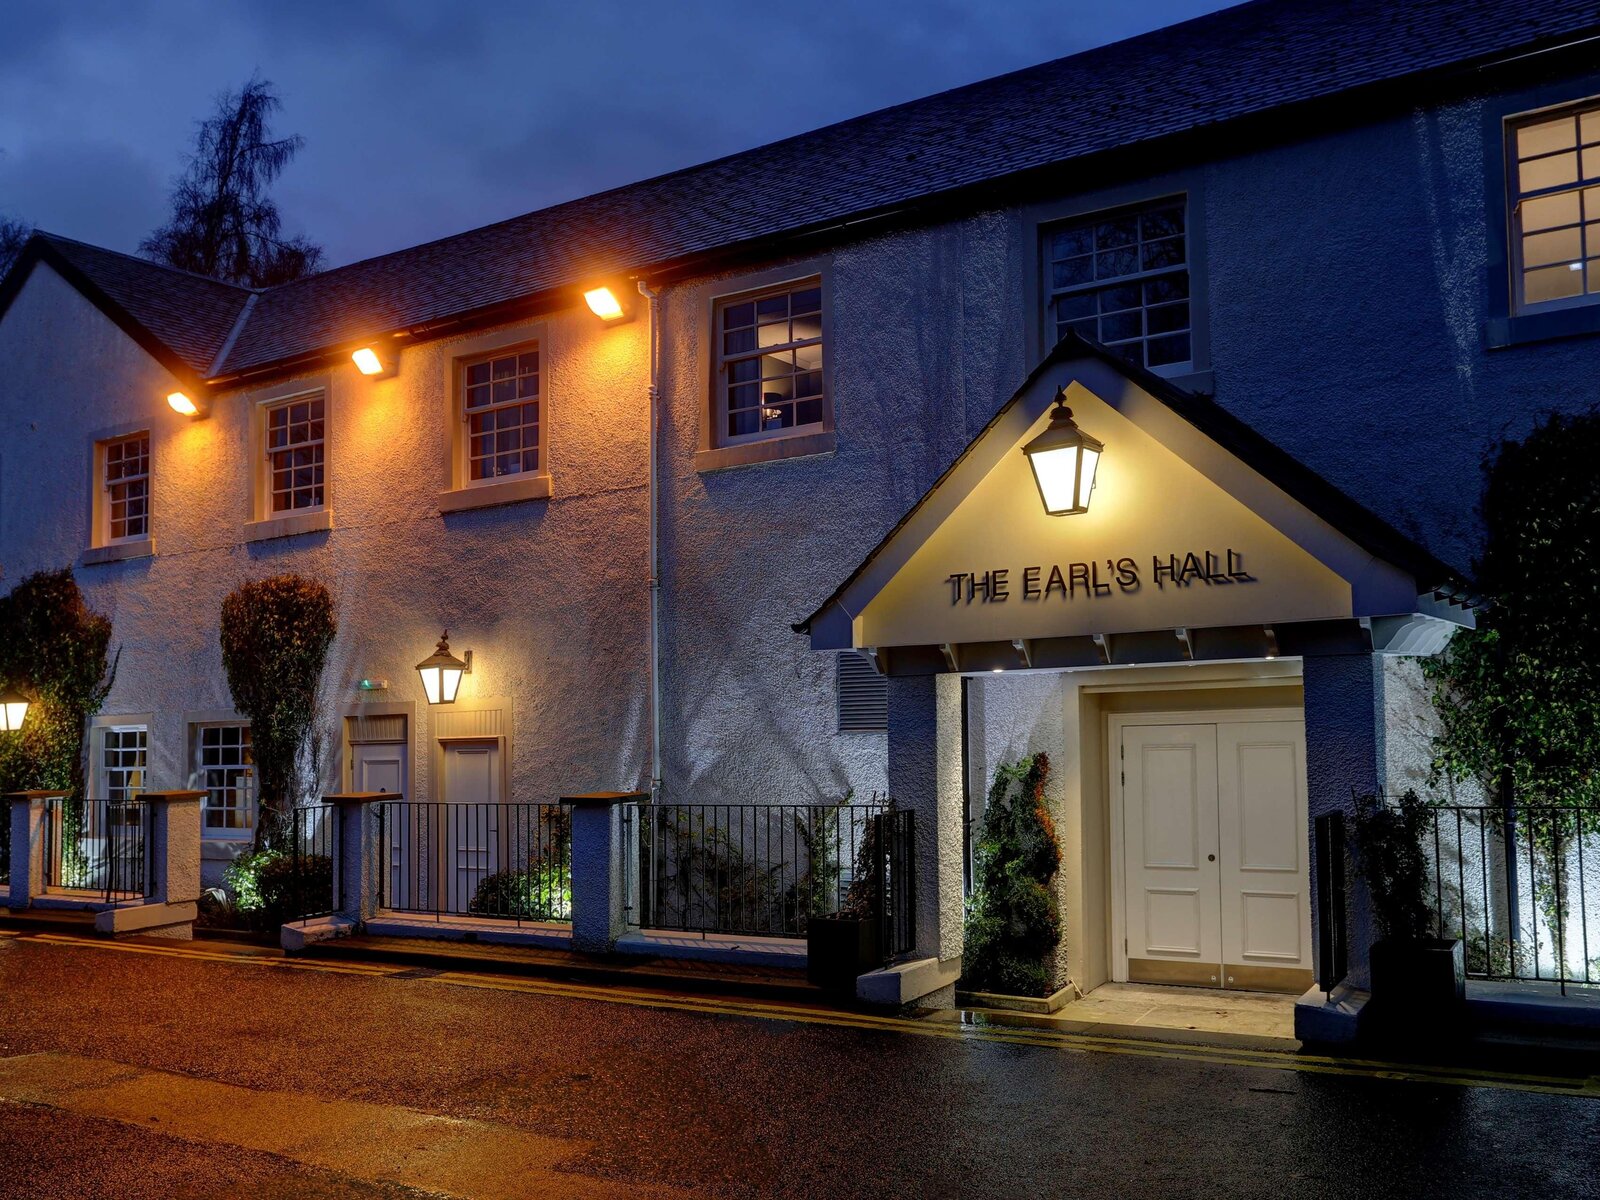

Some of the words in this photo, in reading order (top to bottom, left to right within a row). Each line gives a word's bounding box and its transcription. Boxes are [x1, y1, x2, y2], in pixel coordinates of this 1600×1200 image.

[949, 569, 1010, 600] THE
[1023, 558, 1138, 595] EARL'S
[1152, 548, 1249, 584] HALL
